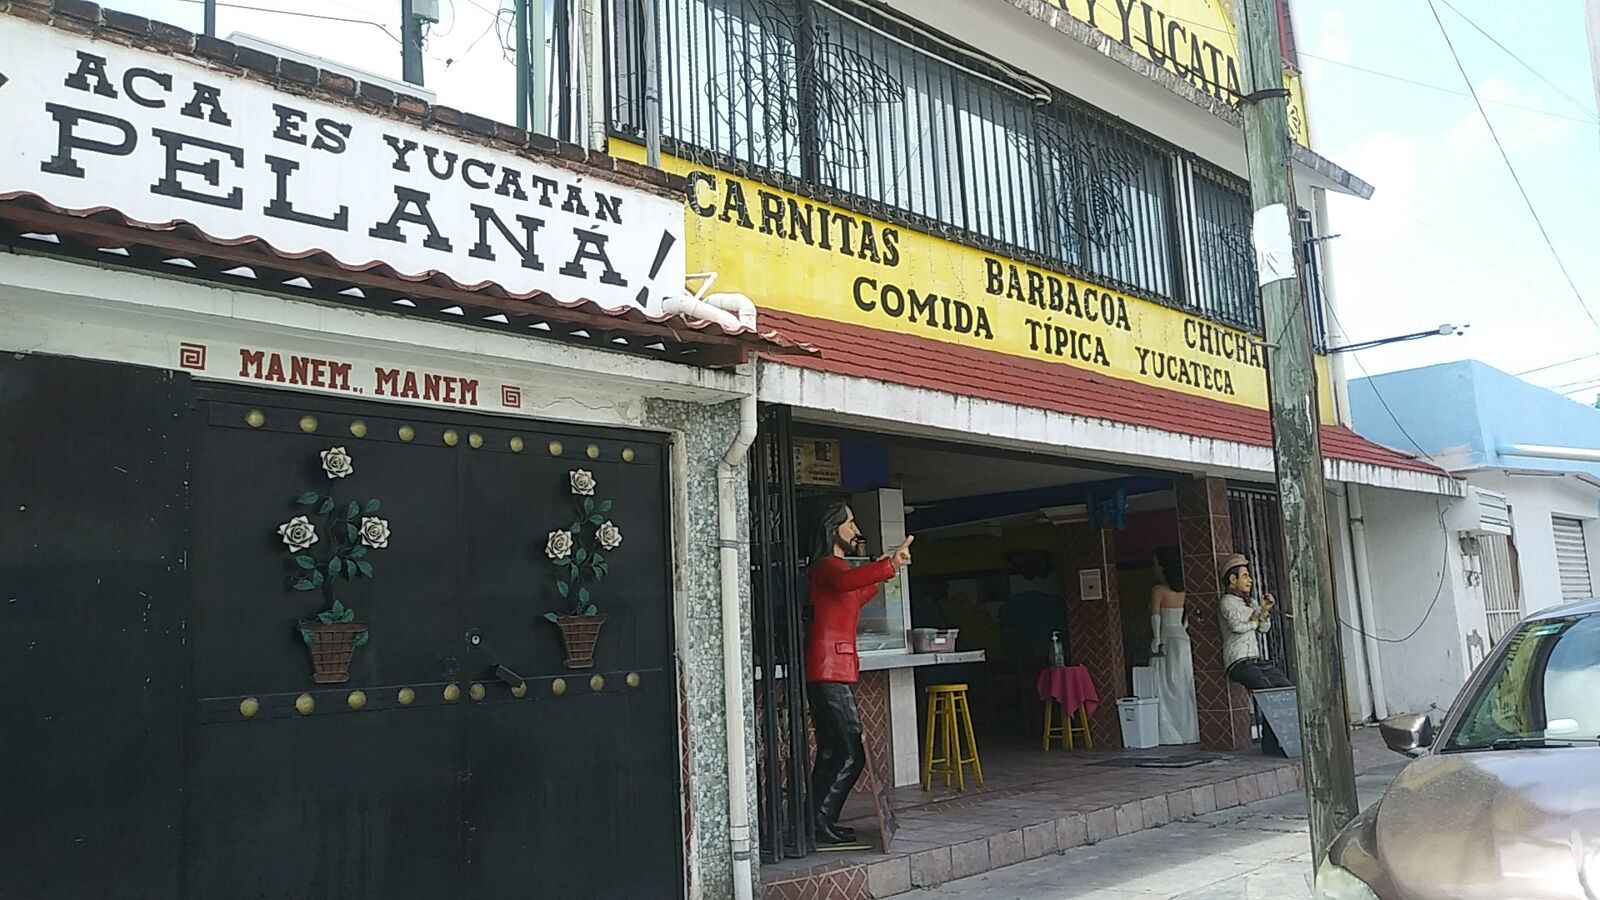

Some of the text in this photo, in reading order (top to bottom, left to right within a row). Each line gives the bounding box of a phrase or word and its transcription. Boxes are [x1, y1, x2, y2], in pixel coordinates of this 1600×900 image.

[1114, 0, 1243, 105] YUCATA
[64, 50, 623, 224] ACA ES YUCATÁN
[686, 170, 1266, 369] CARNITAS BARBACOA CHICHA
[374, 366, 479, 406] MANEM
[853, 277, 1235, 395] COMIDA TÍPICA YUCATECA
